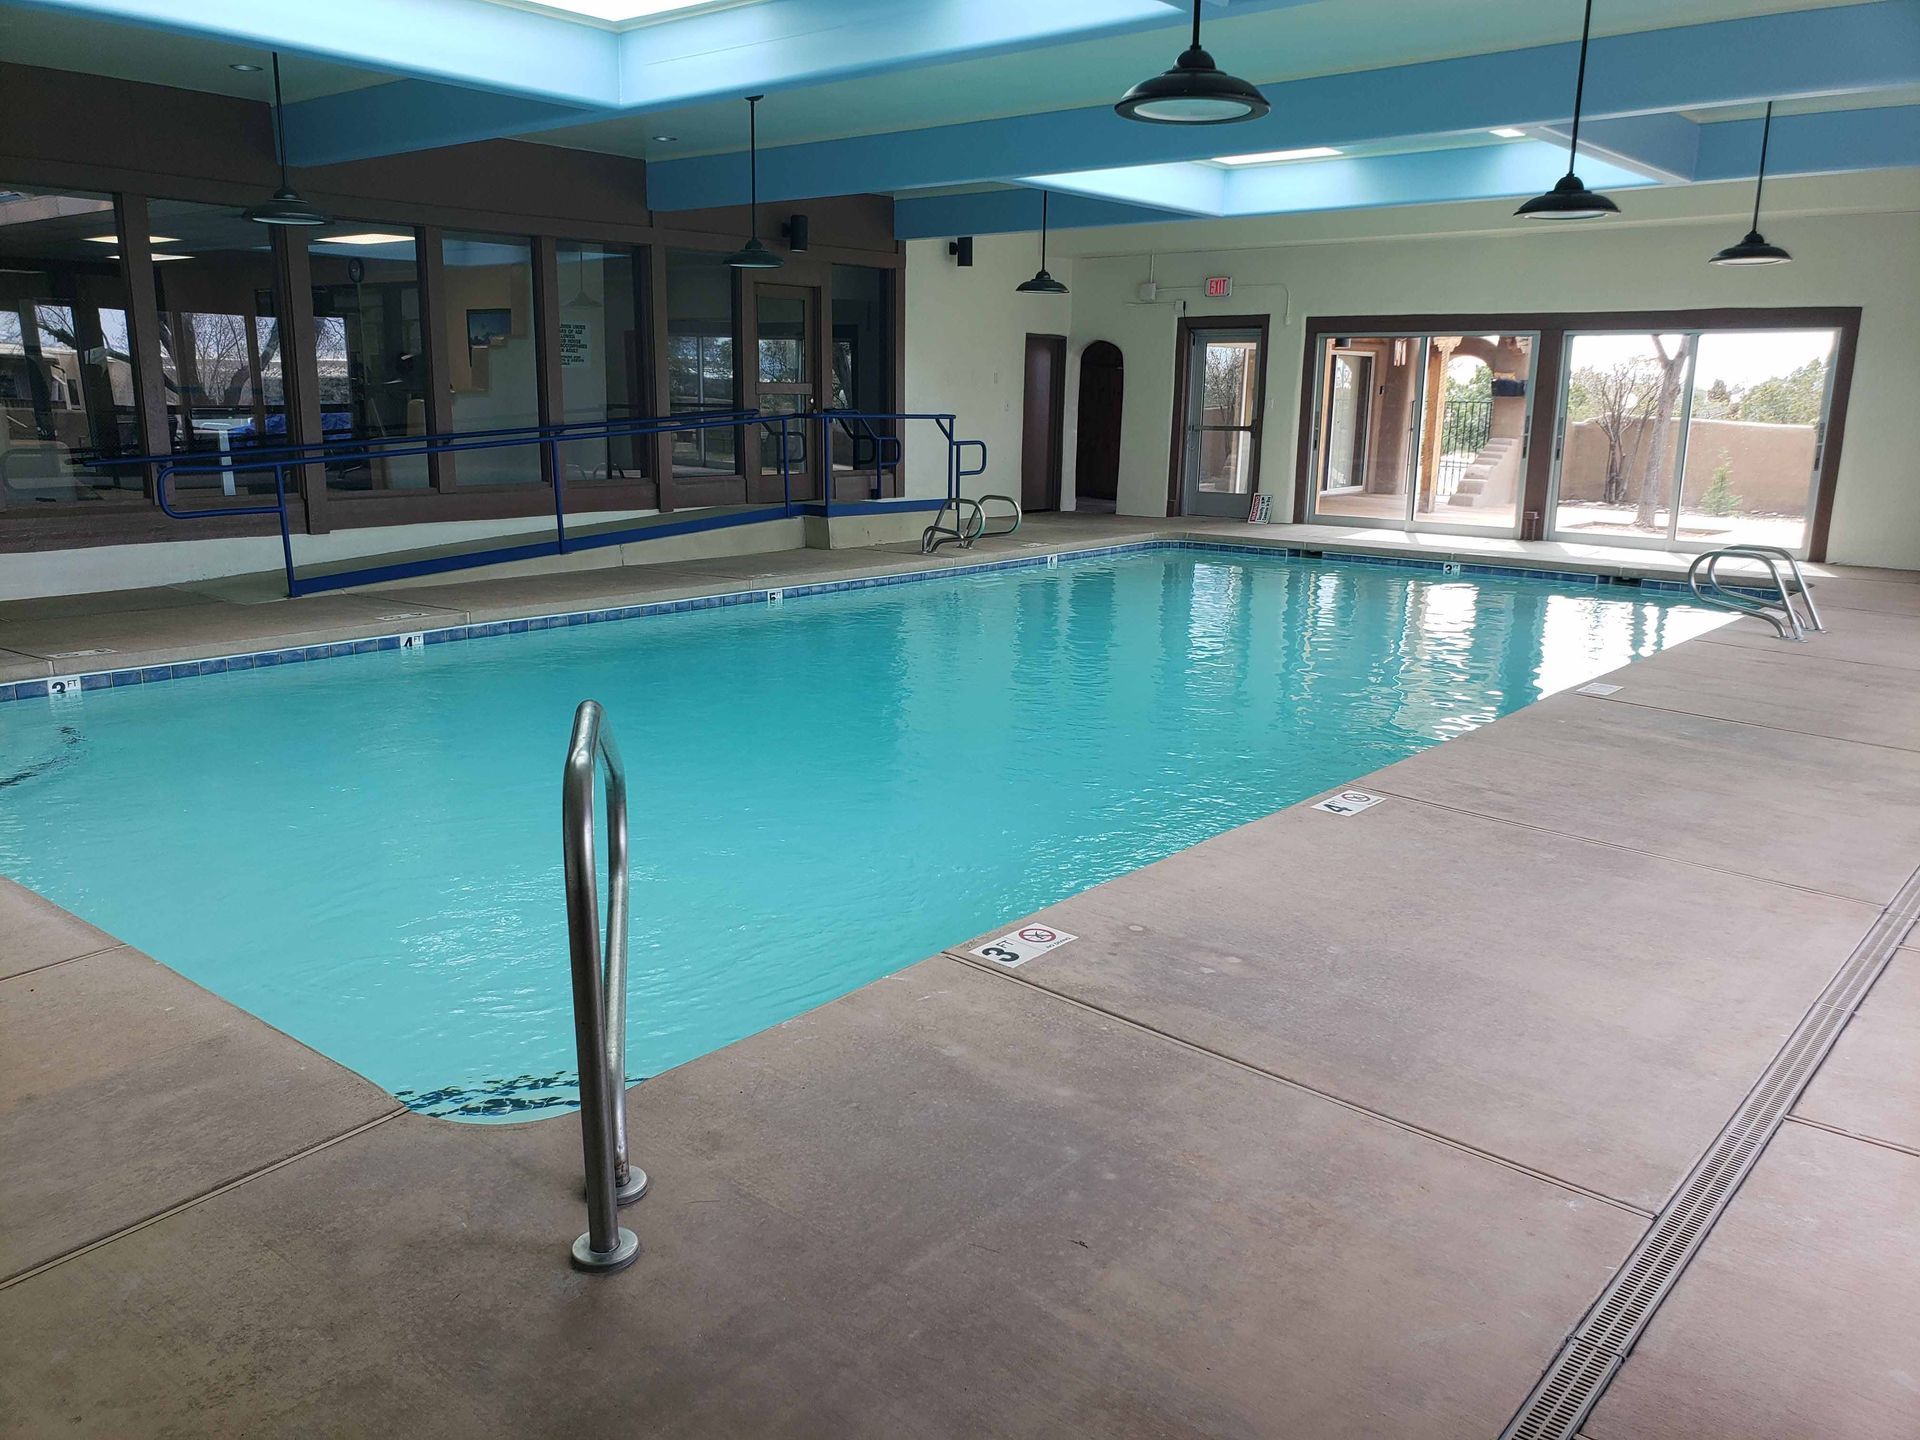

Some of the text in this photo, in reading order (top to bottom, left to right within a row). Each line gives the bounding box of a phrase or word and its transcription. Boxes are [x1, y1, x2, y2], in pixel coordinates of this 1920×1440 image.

[1209, 279, 1227, 295] EXIT
[404, 636, 413, 647] 4
[66, 679, 78, 688] FT
[1323, 803, 1353, 813] 4
[982, 940, 1020, 962] 3 FT
